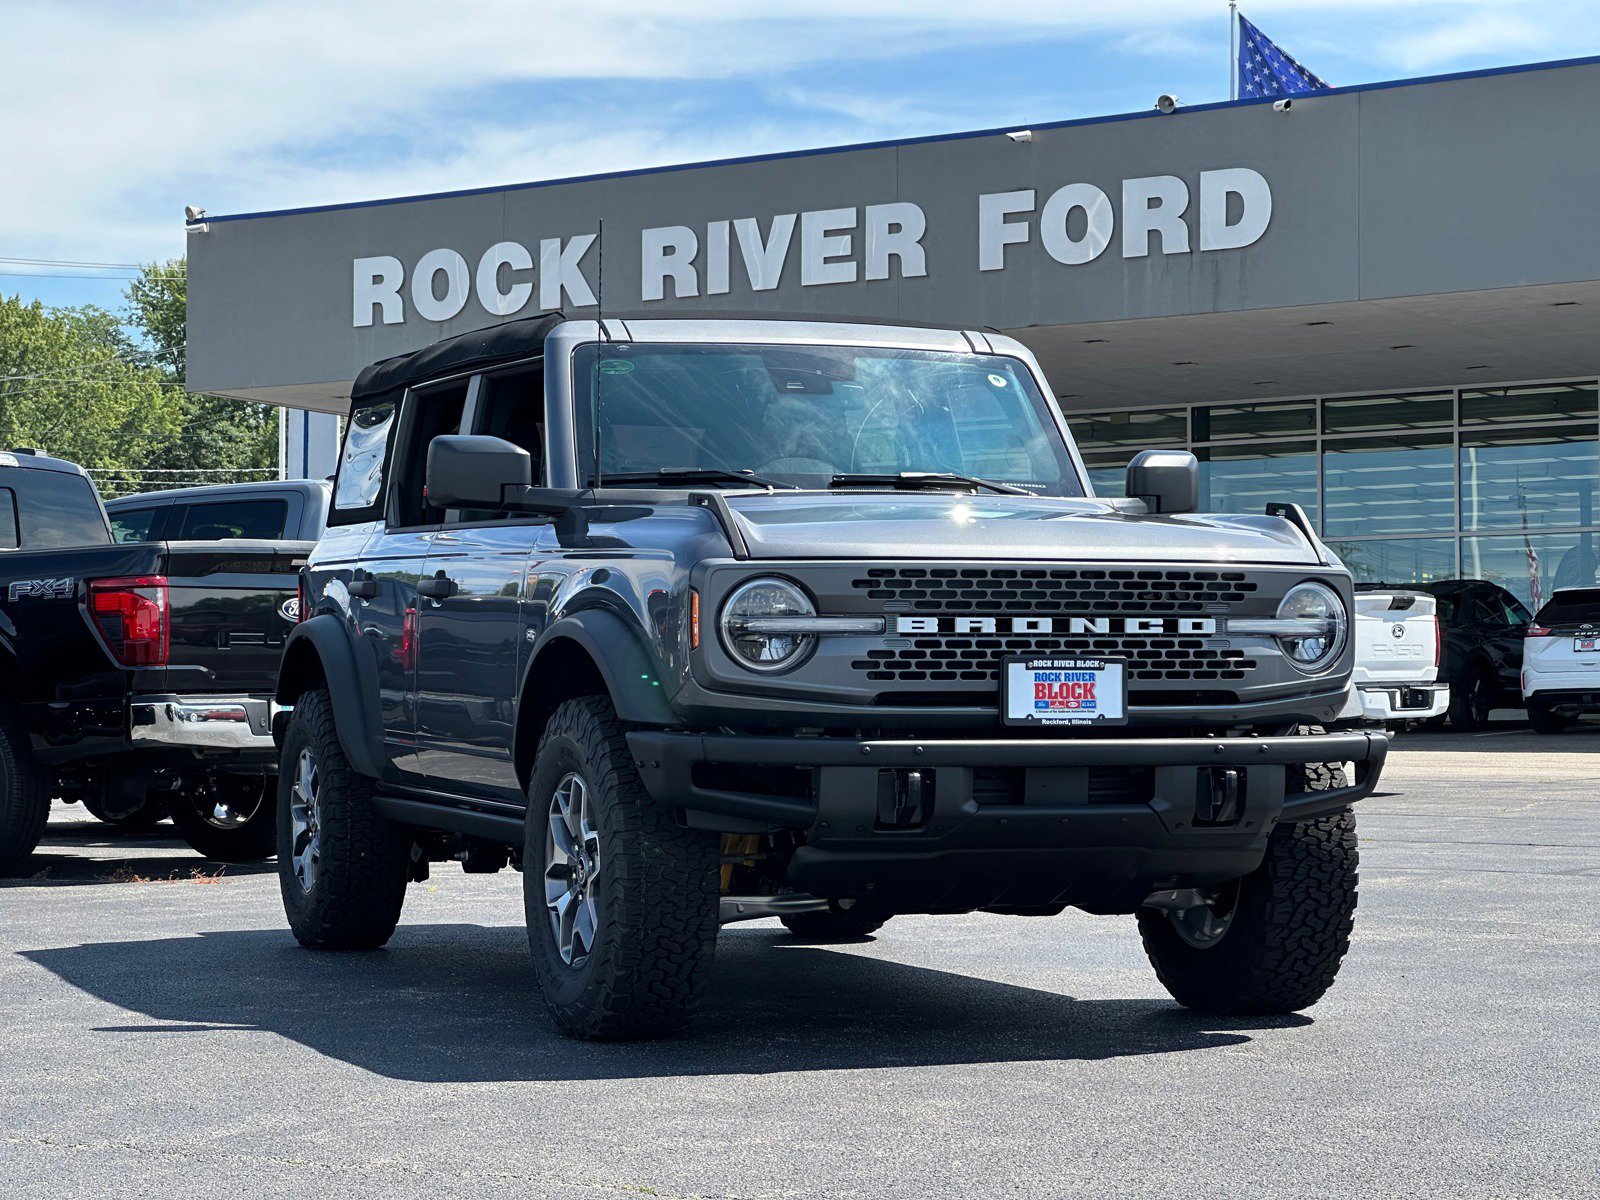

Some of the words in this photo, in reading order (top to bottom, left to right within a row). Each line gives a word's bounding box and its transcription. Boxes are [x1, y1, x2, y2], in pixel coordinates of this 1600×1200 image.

[353, 233, 598, 327] ROCK
[641, 202, 928, 301] RIVER
[979, 167, 1273, 272] FORD
[8, 577, 74, 602] FX4
[897, 617, 1216, 634] BRONCO
[1371, 643, 1424, 659] F-150
[1033, 660, 1053, 668] ROCK
[1053, 660, 1075, 668] RIVER
[1076, 660, 1100, 668] BLOCK
[1034, 672, 1062, 682] ROCK
[1063, 672, 1096, 682] RIVER
[1034, 682, 1097, 700] BLOCK
